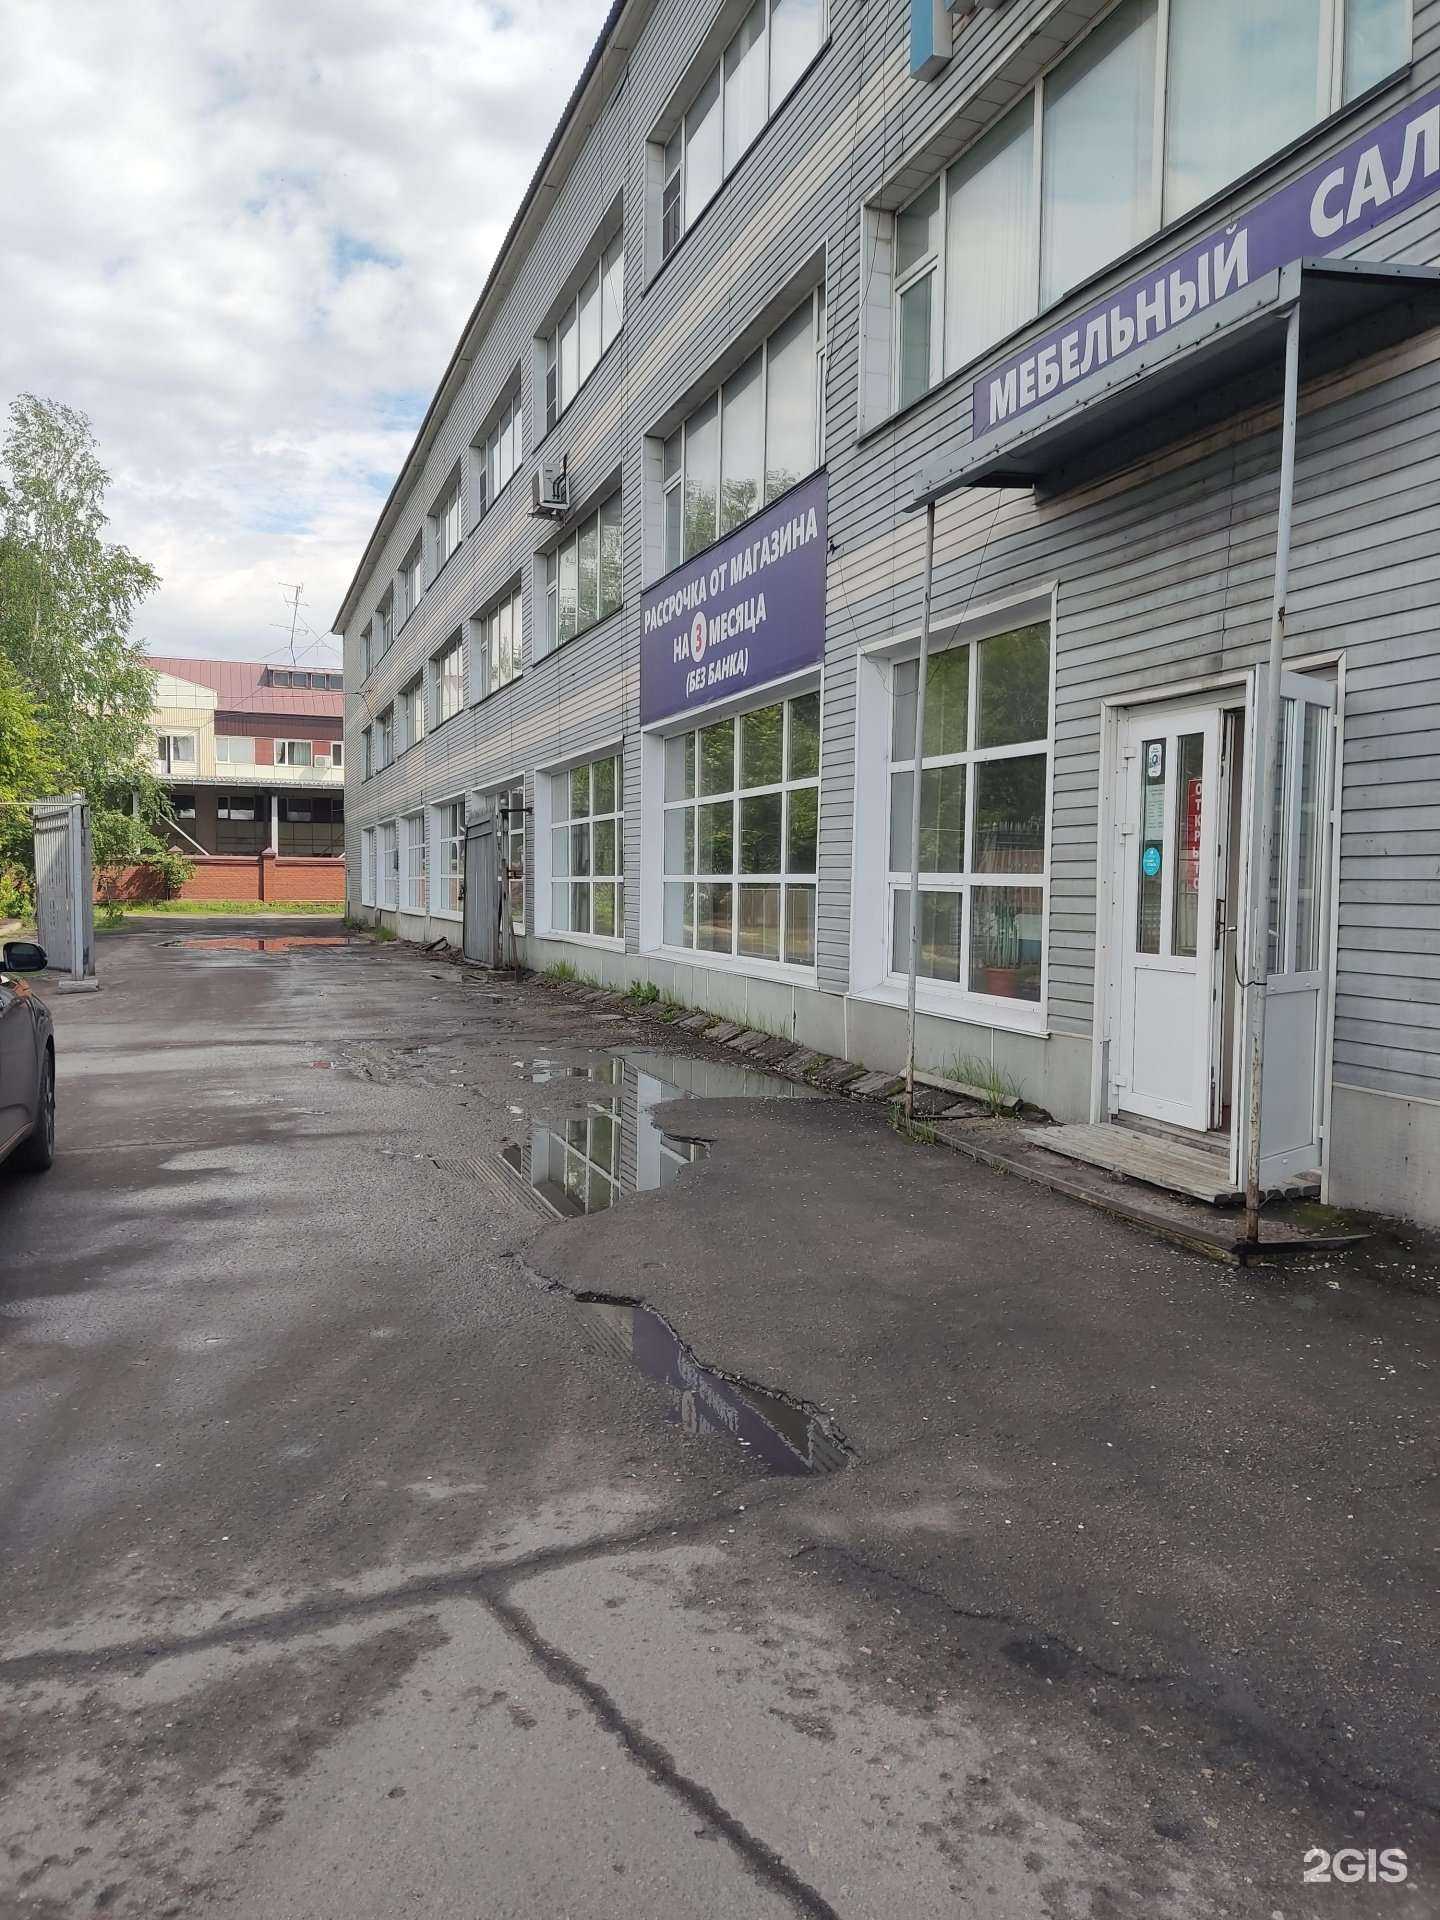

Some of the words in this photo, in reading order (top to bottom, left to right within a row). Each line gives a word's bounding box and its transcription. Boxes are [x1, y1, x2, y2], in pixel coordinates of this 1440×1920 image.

[988, 224, 1251, 426] МЕБЕЛЬНЫЙ
[1309, 104, 1440, 239] САЛ
[643, 576, 707, 634] РАССРОЧКА
[710, 562, 728, 597] ОТ
[730, 507, 818, 587] МАГАЗИНА
[673, 632, 690, 664] НА
[695, 623, 703, 654] 3
[709, 592, 767, 647] МЕСЯЦА
[686, 666, 706, 698] (БЕЗ
[708, 647, 749, 684] БАНКА)
